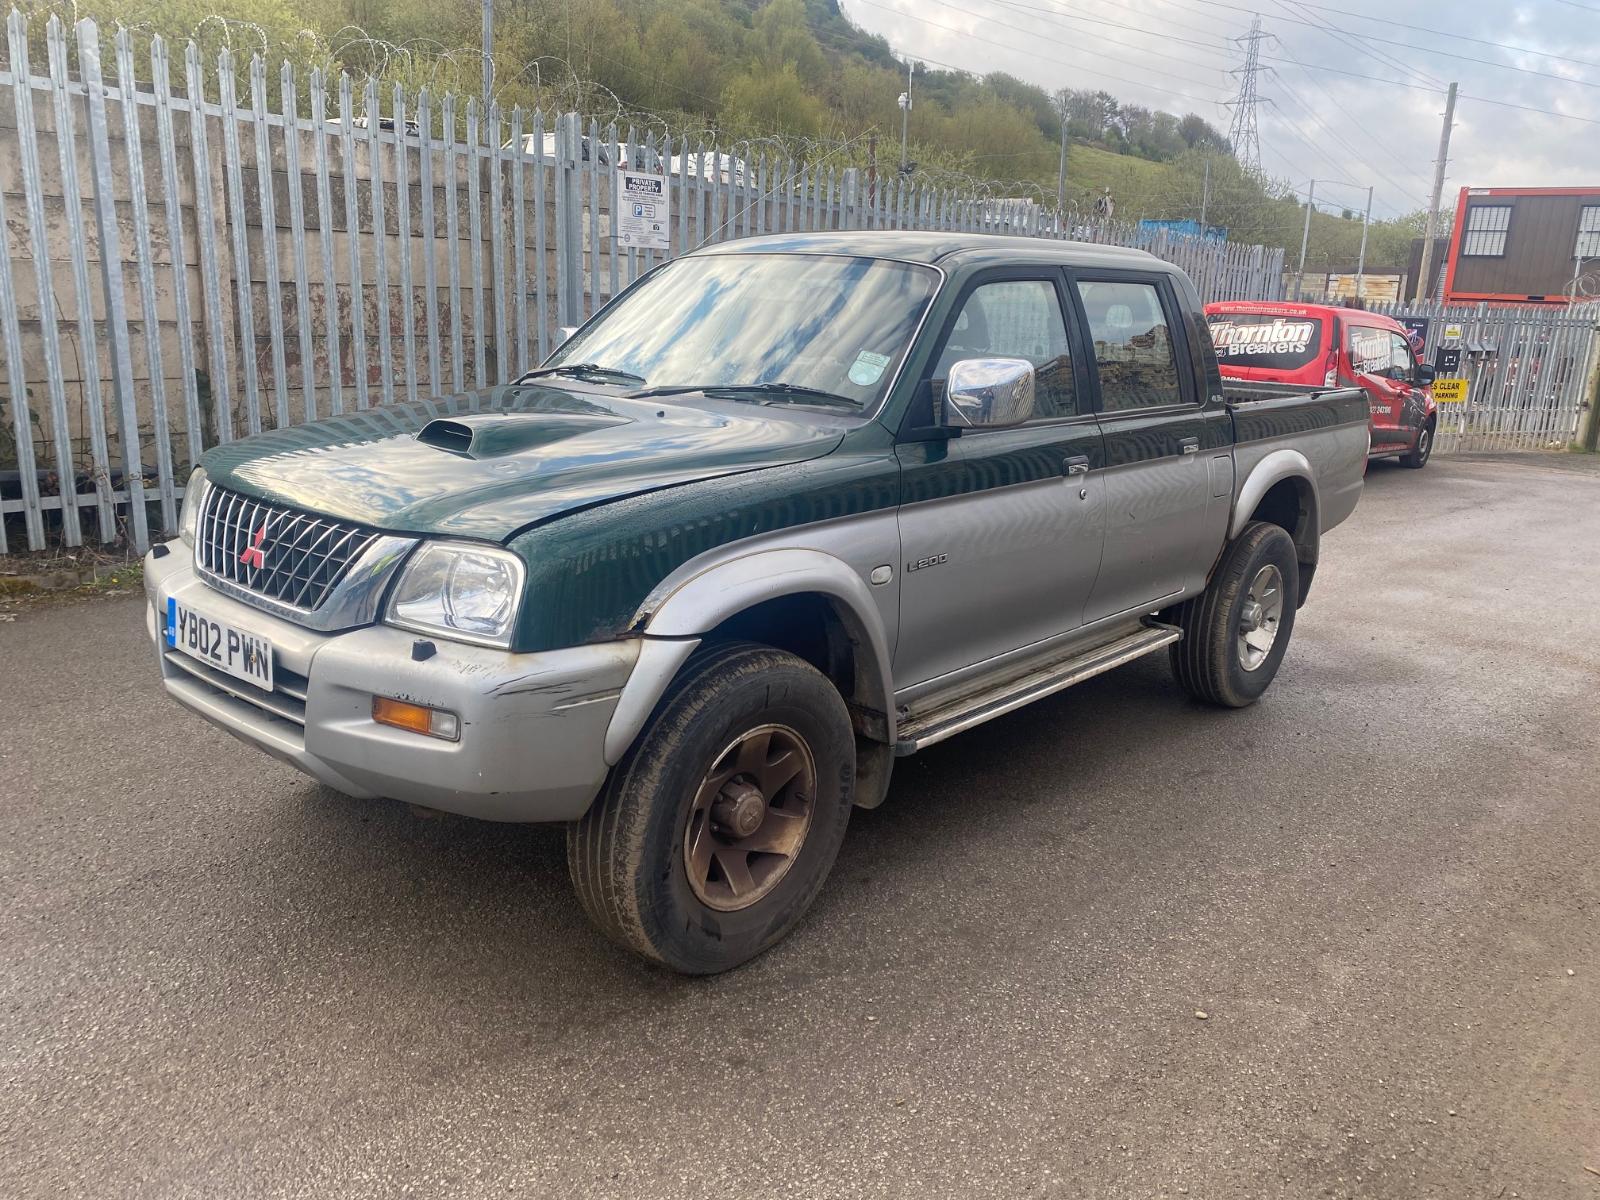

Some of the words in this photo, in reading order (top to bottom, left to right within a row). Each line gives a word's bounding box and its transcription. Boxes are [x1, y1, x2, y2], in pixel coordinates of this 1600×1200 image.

[628, 184, 659, 193] PROPERTY
[631, 178, 656, 187] PRIVATE
[635, 205, 642, 215] P
[1210, 319, 1314, 347] Thornton
[1228, 341, 1306, 356] Breakers
[1439, 382, 1461, 390] CLEAR
[907, 553, 948, 573] L200
[178, 606, 222, 662] YB02
[227, 628, 269, 682] PWN
